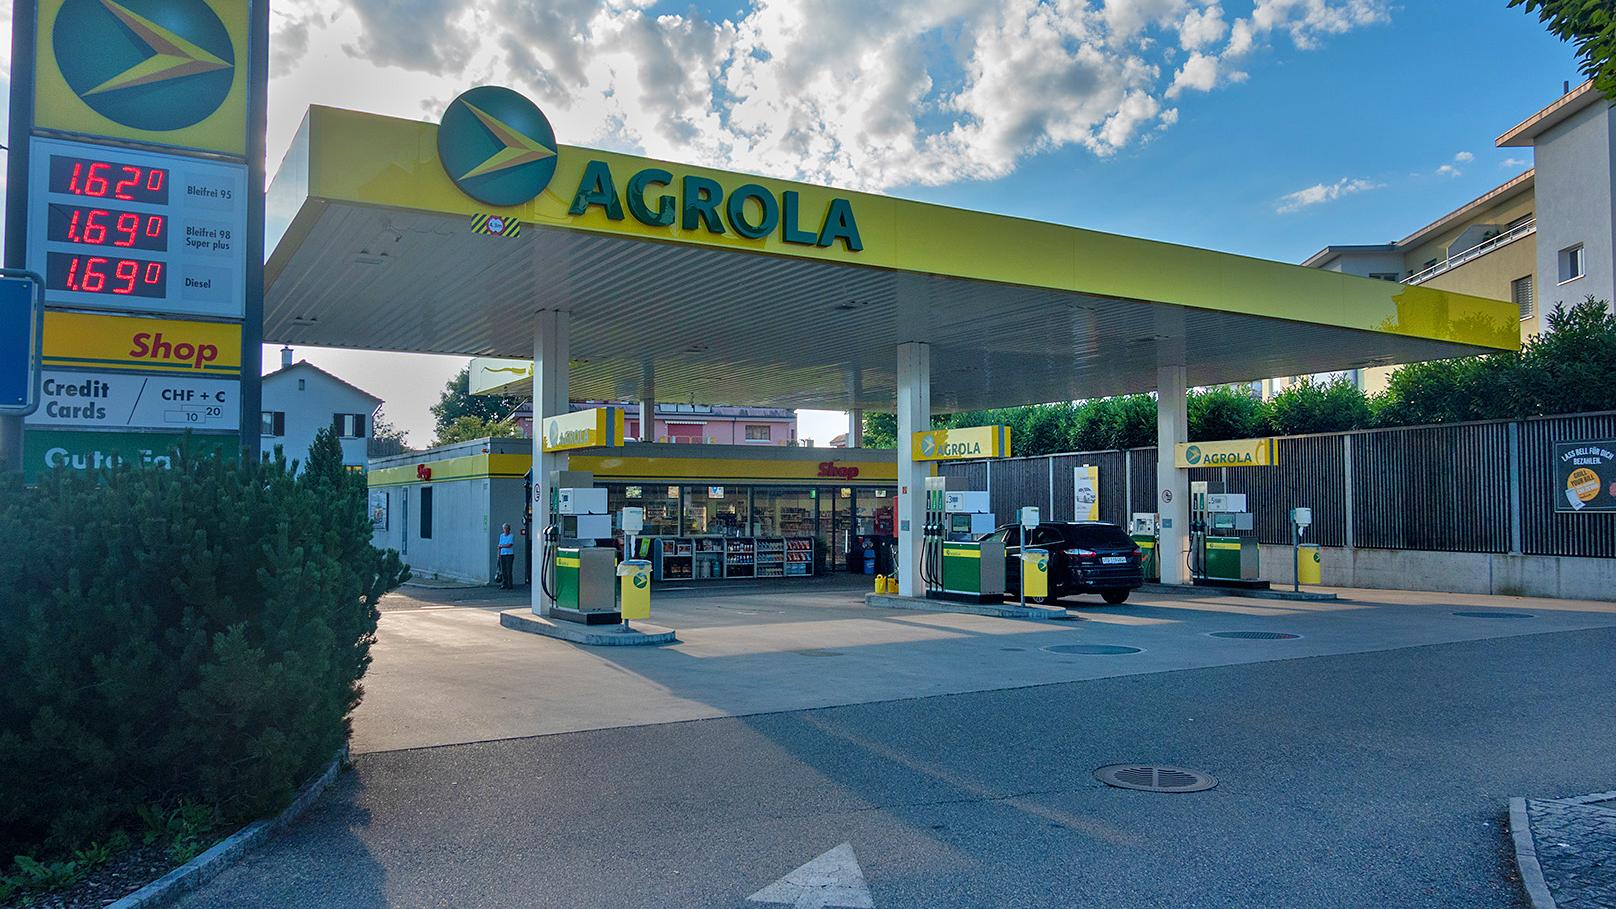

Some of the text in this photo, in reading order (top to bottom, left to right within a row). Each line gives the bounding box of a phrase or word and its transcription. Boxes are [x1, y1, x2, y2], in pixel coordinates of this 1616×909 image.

[186, 185, 232, 199] Bleifrei 95
[567, 160, 864, 251] AGROLA
[186, 226, 231, 239] Bleifrei 98
[186, 237, 230, 250] Super plus
[185, 277, 211, 289] Diesel
[129, 332, 218, 369] Shop
[43, 378, 110, 398] Credit
[161, 388, 194, 401] CHF
[46, 400, 106, 420] Cards
[206, 406, 221, 416] 20
[186, 412, 198, 422] 10
[937, 442, 981, 456] AGROLA
[1203, 452, 1252, 465] AGROLA
[817, 461, 859, 480] Shop
